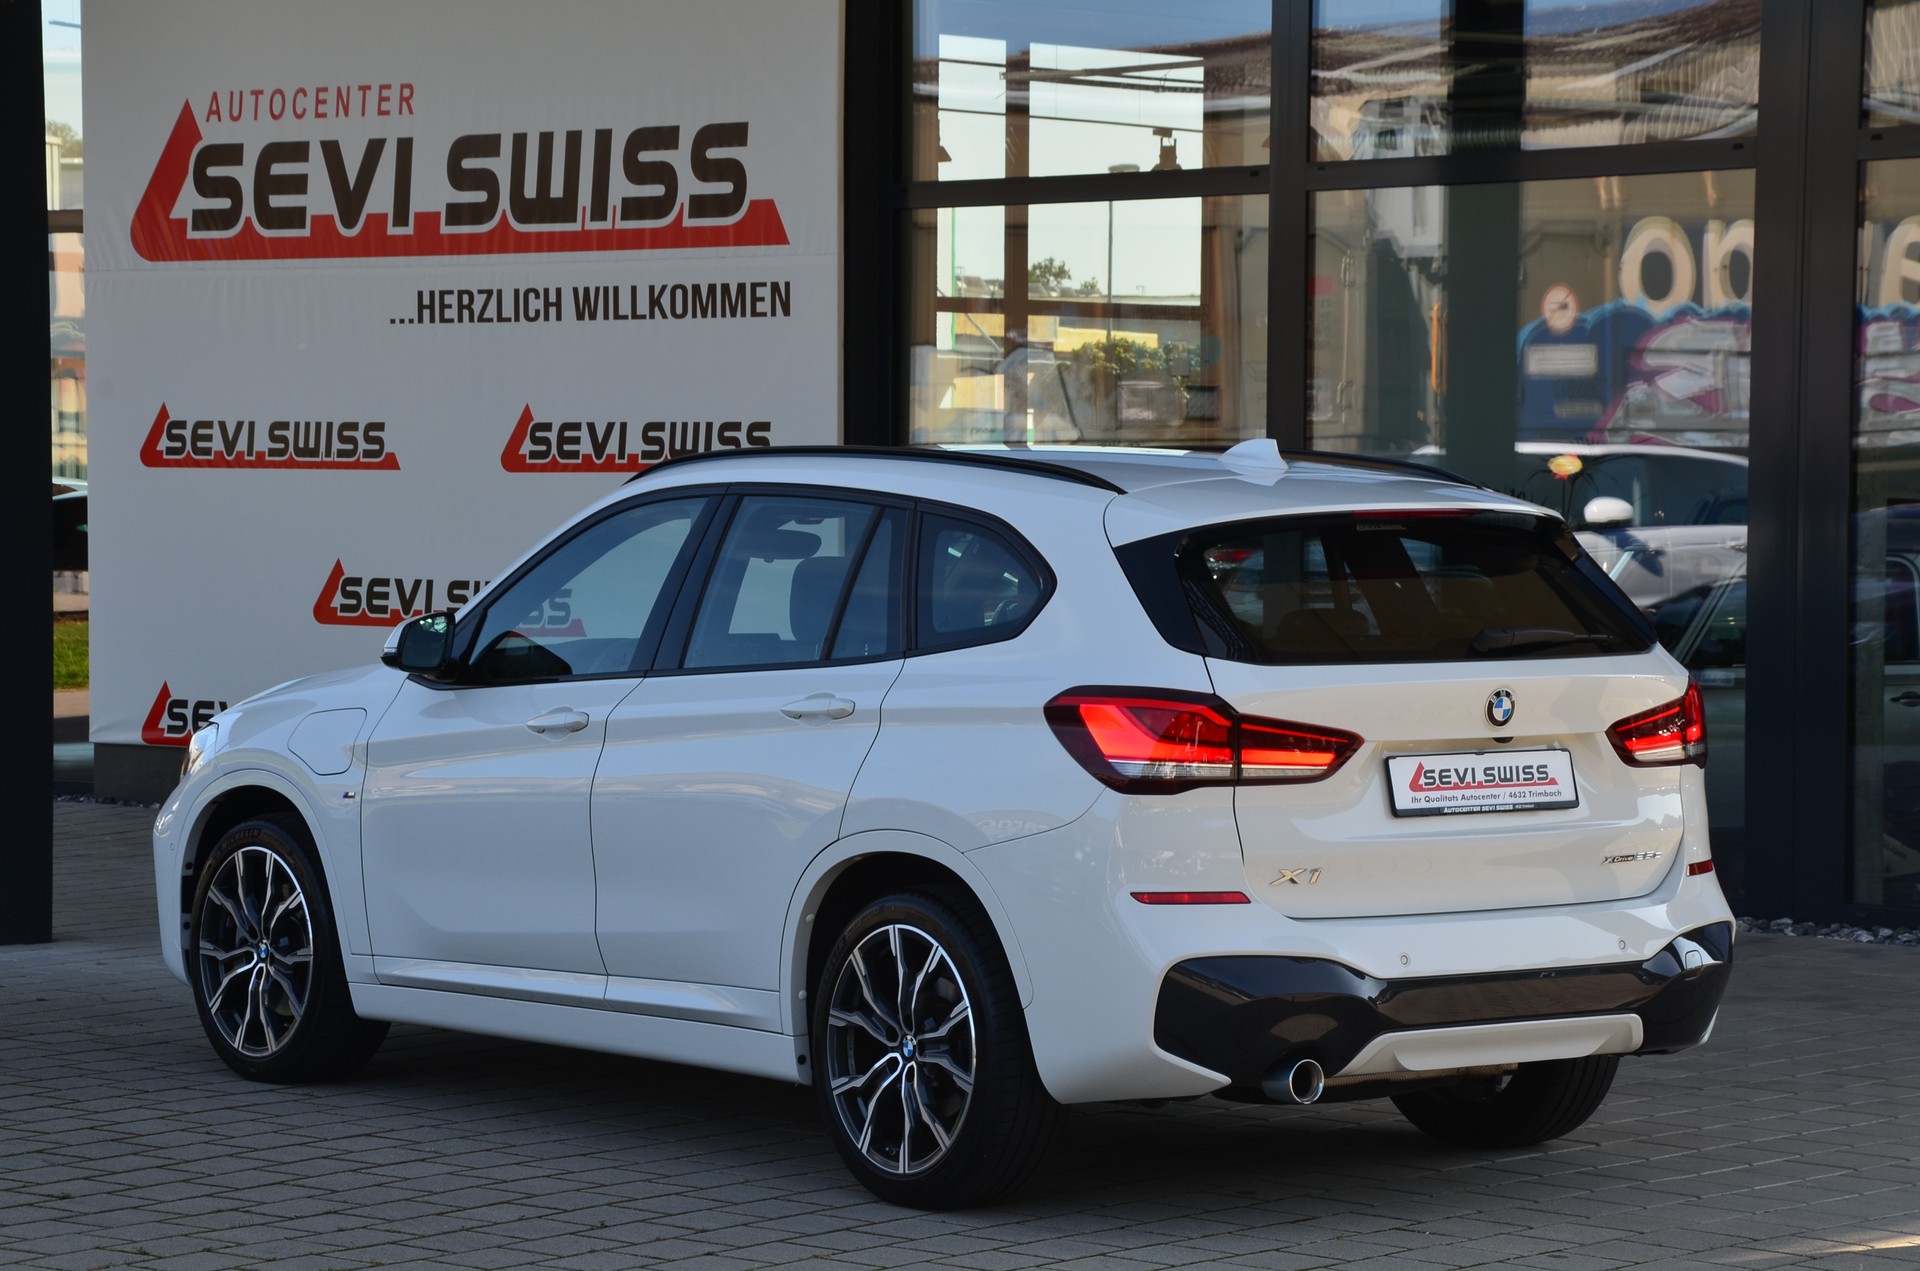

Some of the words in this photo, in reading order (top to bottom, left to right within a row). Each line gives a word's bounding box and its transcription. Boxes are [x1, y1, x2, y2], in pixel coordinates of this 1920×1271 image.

[205, 83, 415, 122] AUTOCENTER
[191, 137, 414, 232] SEVI
[444, 121, 750, 227] SWISS
[572, 281, 791, 321] WILLKOMMEN
[165, 420, 256, 458] SEVI
[267, 421, 386, 460] SWISS
[528, 421, 628, 460] SEVI
[640, 421, 771, 460] SWISS
[340, 577, 434, 616] SEVI
[167, 699, 228, 735] SE
[1423, 767, 1476, 786] SEVI
[1483, 764, 1549, 783] SWISS
[1411, 796, 1422, 804] Ihr
[1460, 793, 1501, 802] Autocenter
[1508, 791, 1527, 800] 4632
[1528, 789, 1562, 799] Trimbach
[1269, 868, 1322, 886] X1
